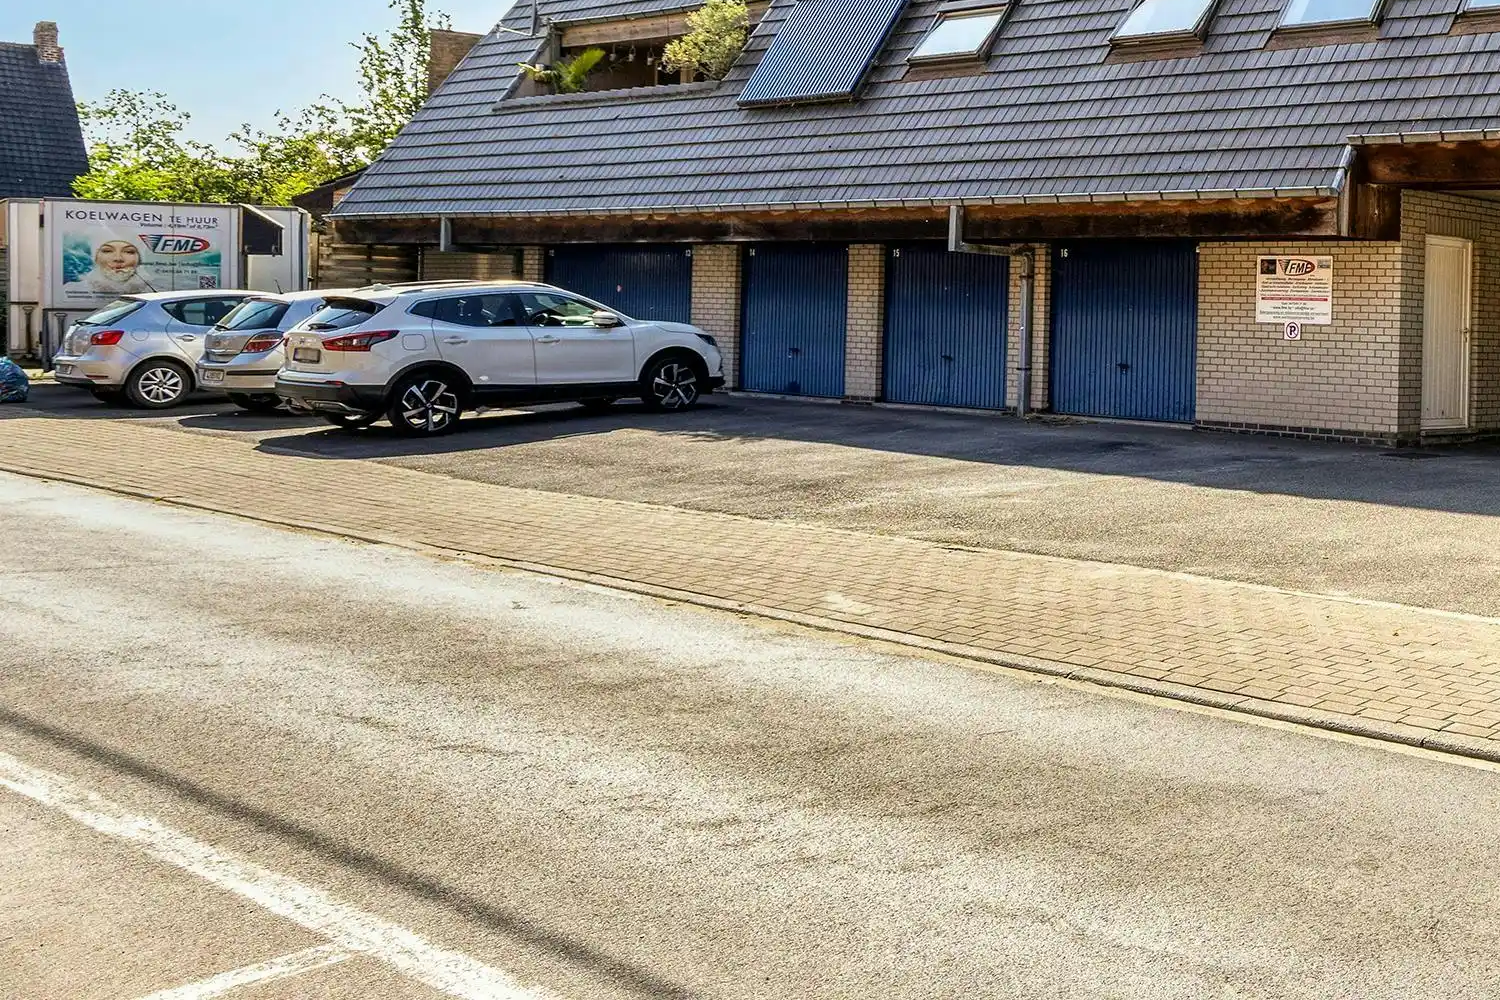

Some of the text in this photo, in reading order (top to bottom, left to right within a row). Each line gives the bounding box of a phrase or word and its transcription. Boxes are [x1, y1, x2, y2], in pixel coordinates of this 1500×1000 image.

[65, 210, 162, 223] KOELWAGEN
[186, 216, 218, 225] HUUR
[161, 239, 201, 252] FME
[749, 248, 756, 257] 14
[893, 248, 900, 258] 15
[1060, 248, 1068, 258] 16
[1289, 263, 1312, 273] FME
